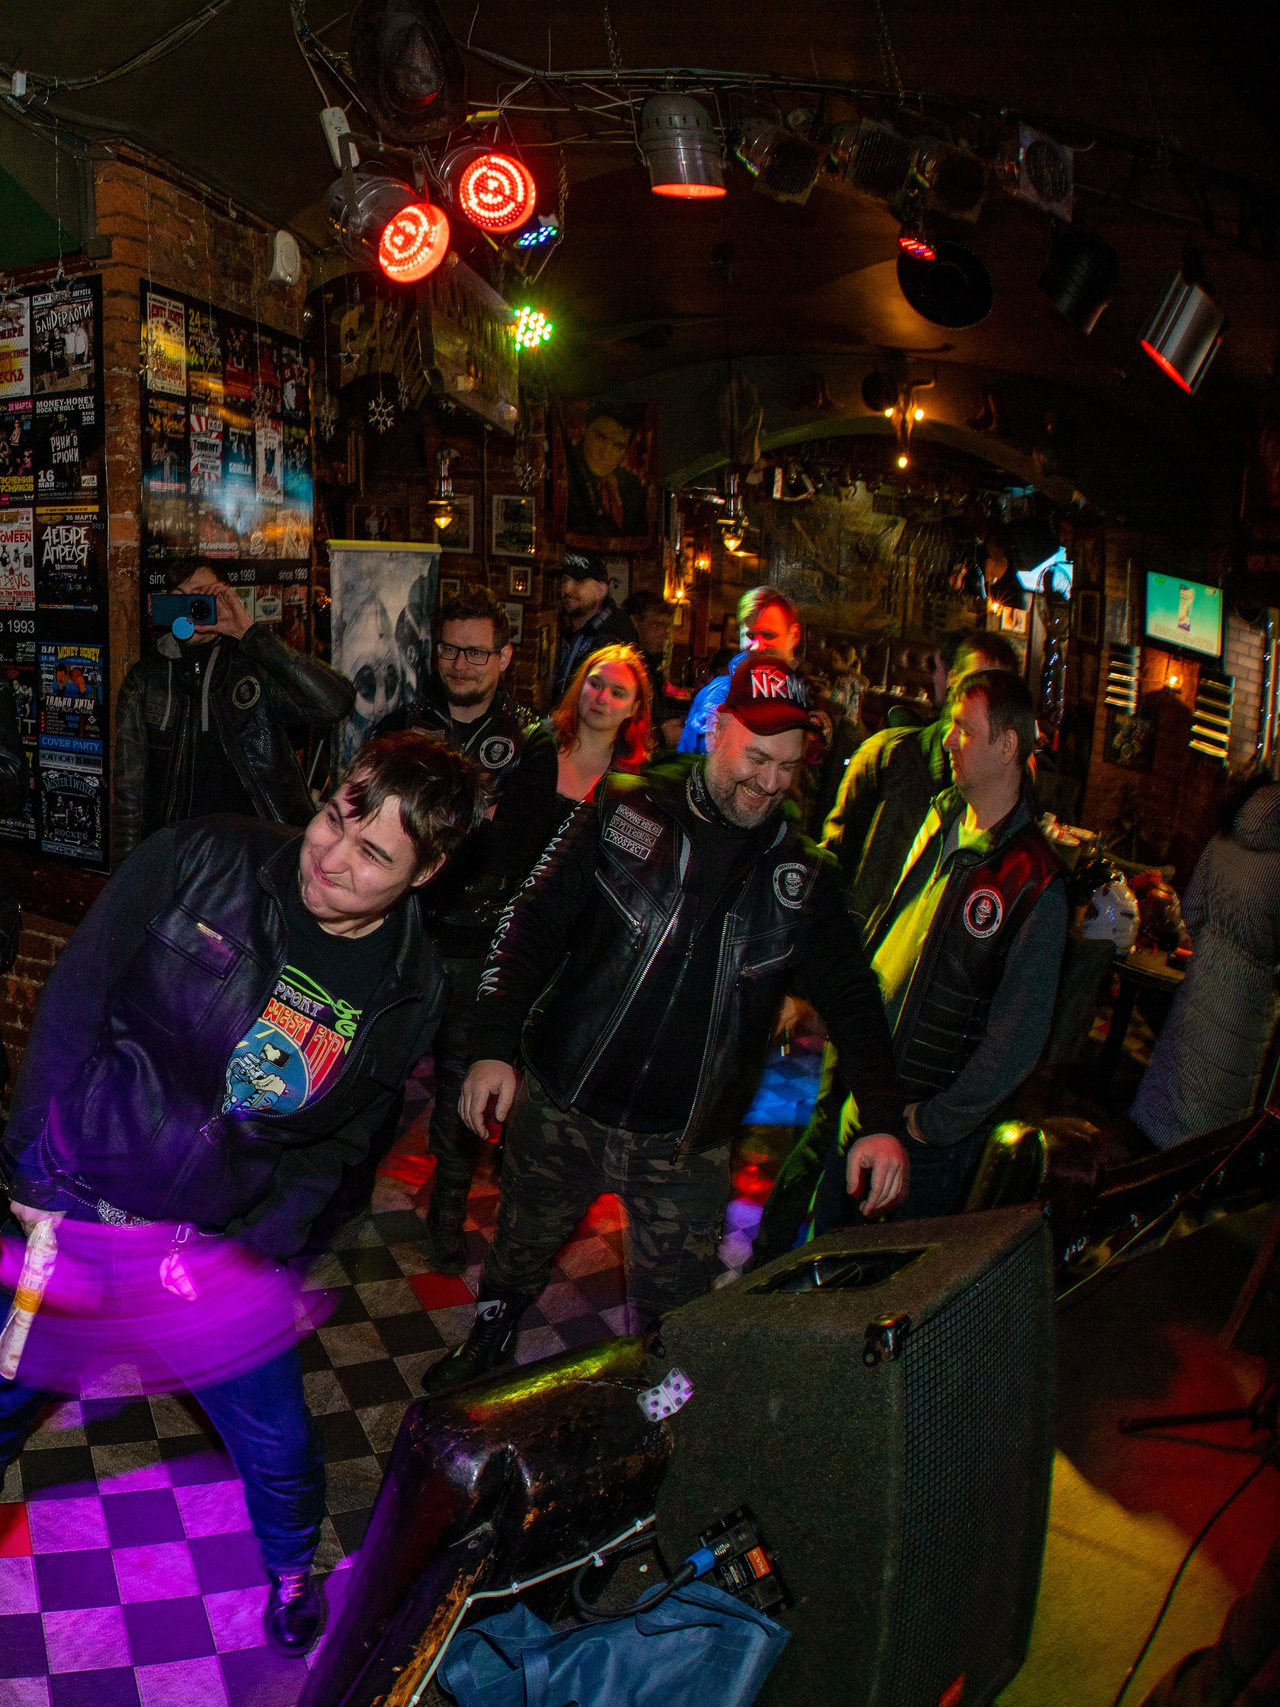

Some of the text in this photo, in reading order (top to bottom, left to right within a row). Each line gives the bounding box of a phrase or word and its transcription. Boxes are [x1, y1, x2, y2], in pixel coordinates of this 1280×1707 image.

[53, 448, 79, 464] БРЮКИ
[38, 470, 55, 483] 16
[239, 568, 256, 582] 1993
[7, 619, 36, 634] 1993
[57, 645, 101, 663] MONEY HONEY
[74, 698, 95, 711] ХИТЫ
[41, 736, 100, 751] COVER PARTY
[54, 828, 89, 840] ROCKER
[608, 830, 646, 855] PROSPECT
[273, 980, 325, 1018] PPORT
[262, 996, 313, 1047] WEST
[305, 1023, 346, 1095] END
